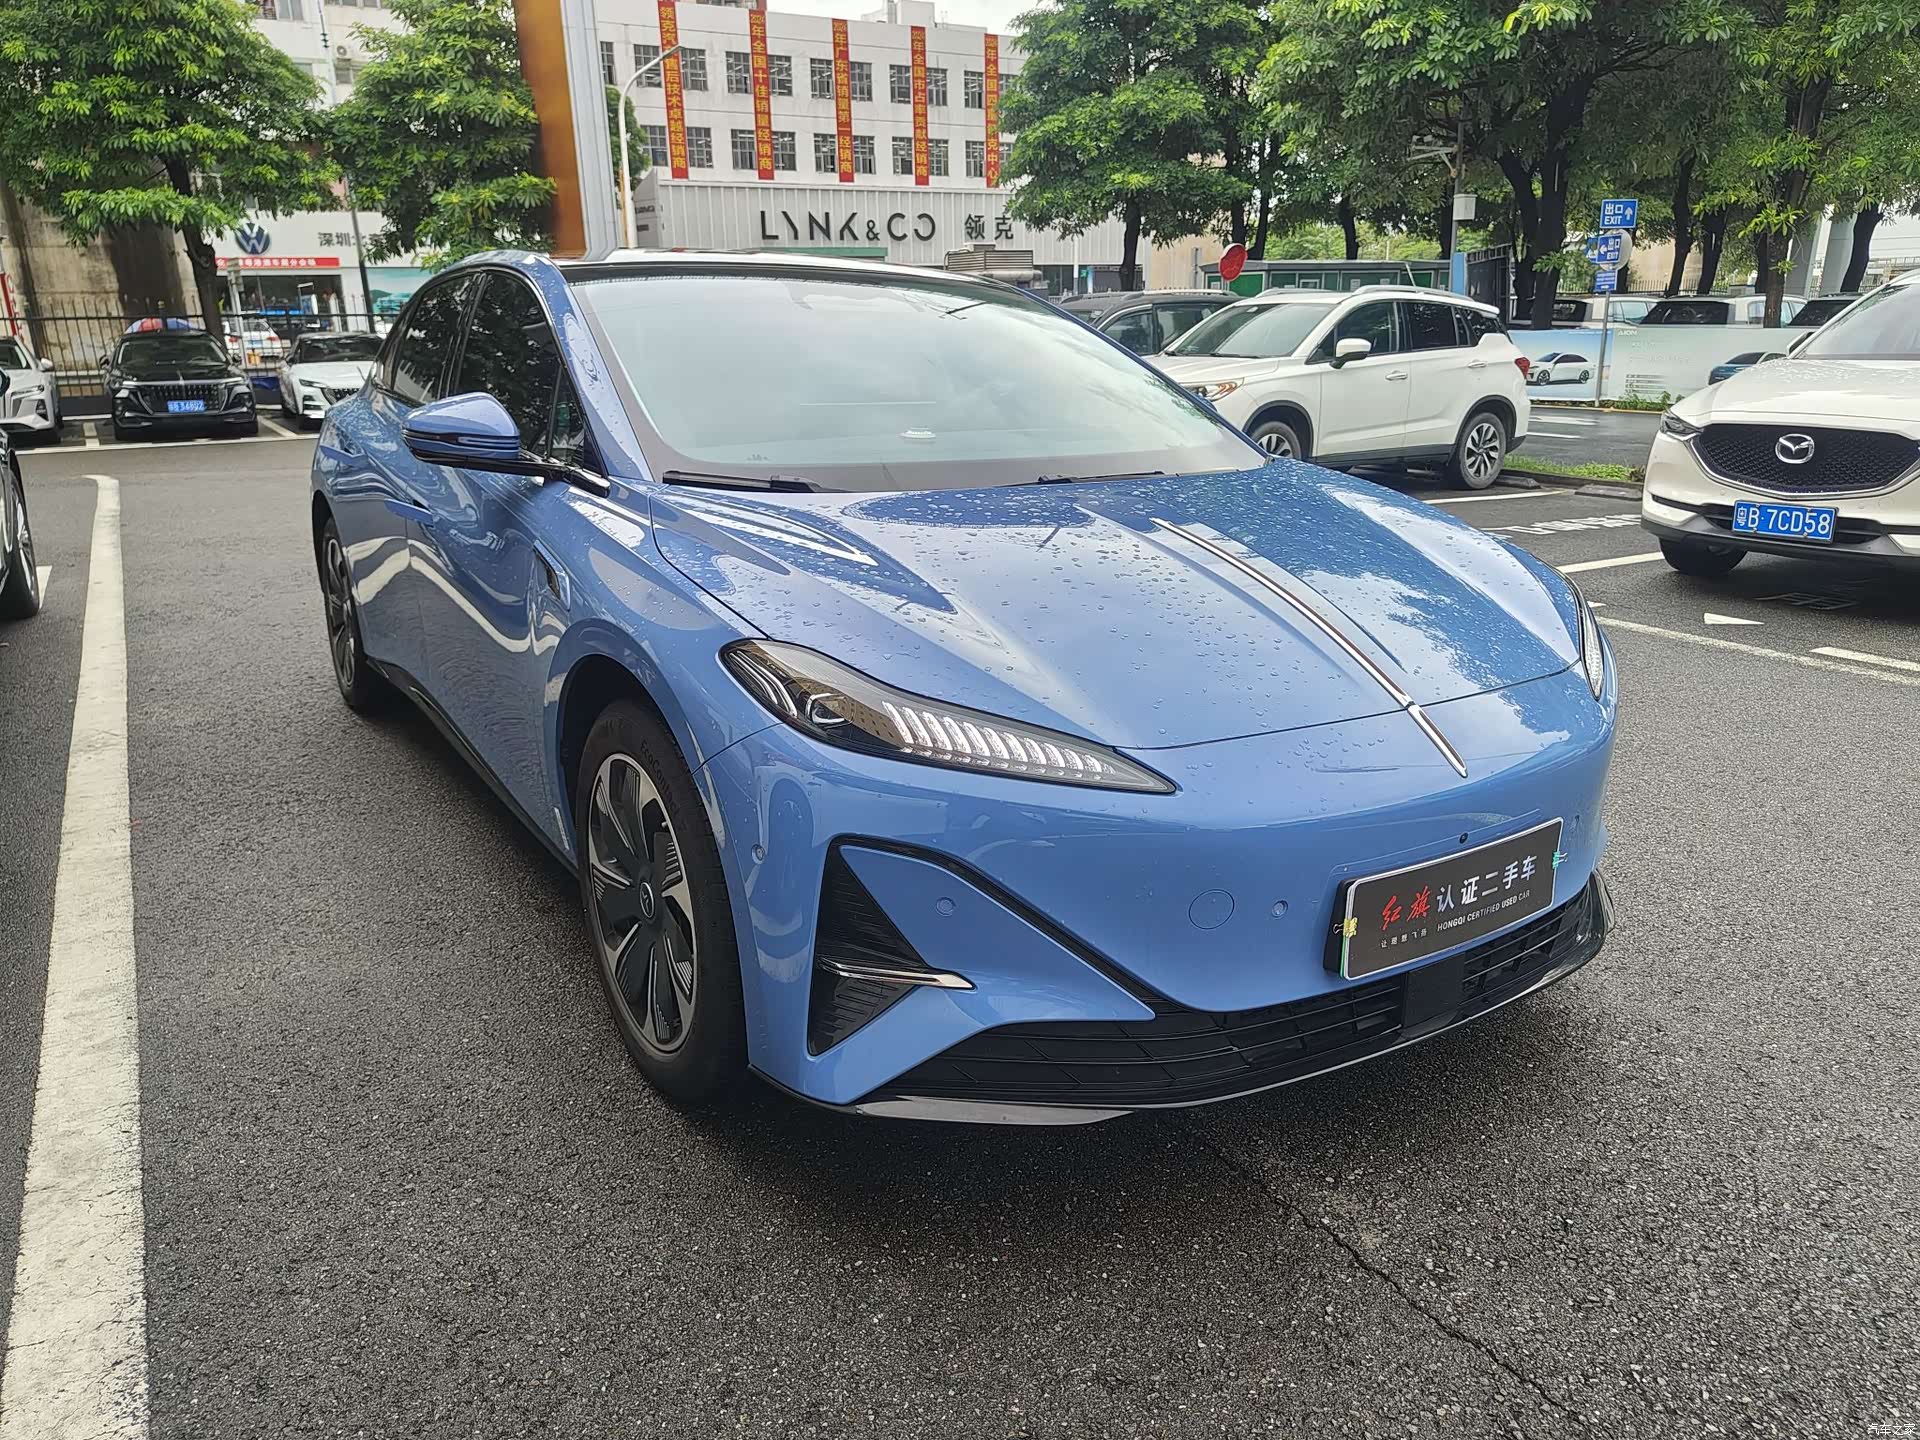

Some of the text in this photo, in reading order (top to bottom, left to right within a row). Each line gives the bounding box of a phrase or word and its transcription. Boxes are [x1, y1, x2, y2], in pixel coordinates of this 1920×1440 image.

[1605, 203, 1623, 215] 出口
[965, 214, 1014, 240] 领克
[1604, 216, 1622, 225] EXIT
[1437, 889, 1530, 932] HONGQI CERTIFIED USED CAR
